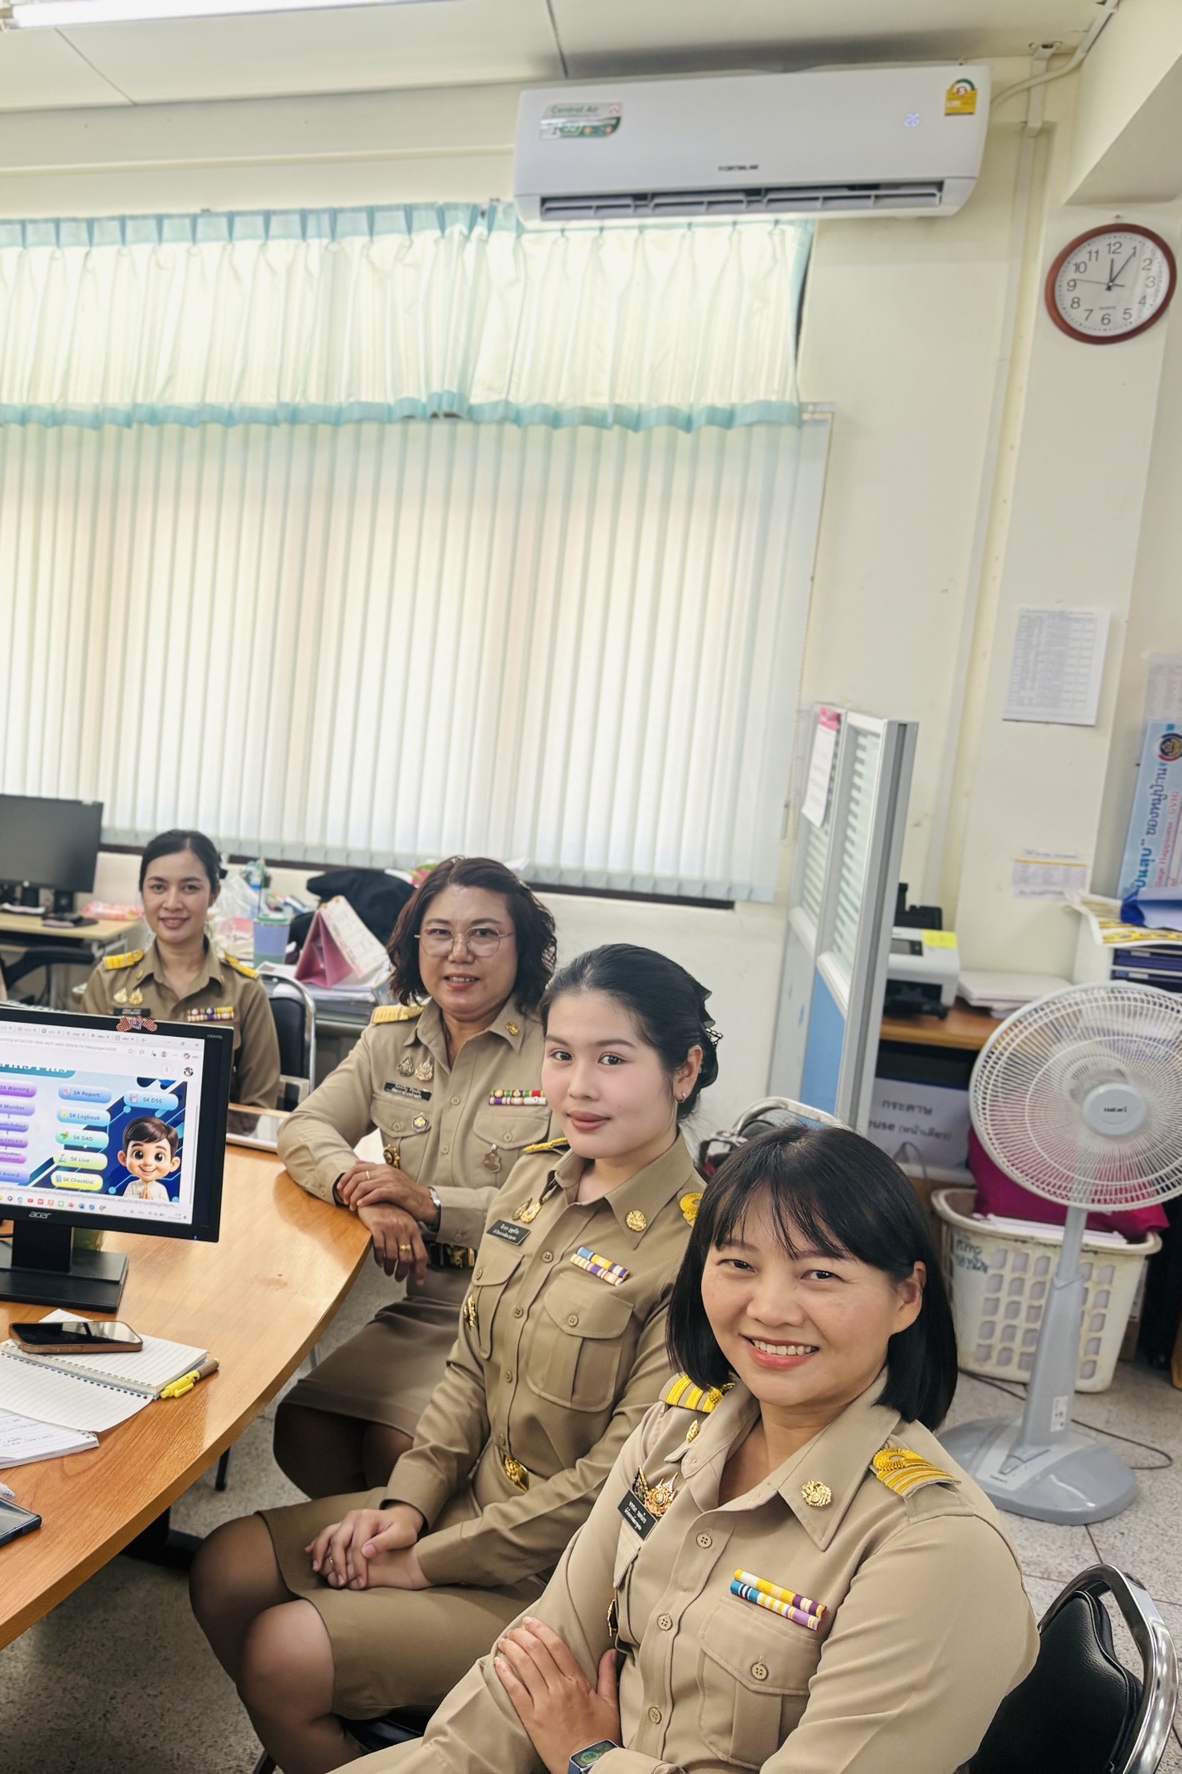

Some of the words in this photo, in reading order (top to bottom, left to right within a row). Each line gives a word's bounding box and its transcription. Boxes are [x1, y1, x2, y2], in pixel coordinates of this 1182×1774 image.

[1106, 241, 1122, 255] 12
[1087, 249, 1100, 262] 11
[1073, 261, 1088, 274] 10
[1142, 258, 1153, 271] 2
[1066, 279, 1077, 292] 9
[1145, 275, 1156, 288] 3
[1070, 296, 1081, 309] 8
[1137, 295, 1147, 306] 4
[1084, 308, 1094, 321] 7
[1100, 313, 1111, 326] 6
[1122, 307, 1133, 321] 5
[8, 1085, 30, 1093] Warning
[81, 1091, 100, 1099] Report
[882, 1100, 933, 1116] กระดาษ
[77, 1113, 100, 1121] Logbook
[70, 1177, 94, 1185] Checklist
[28, 1211, 51, 1219] acer
